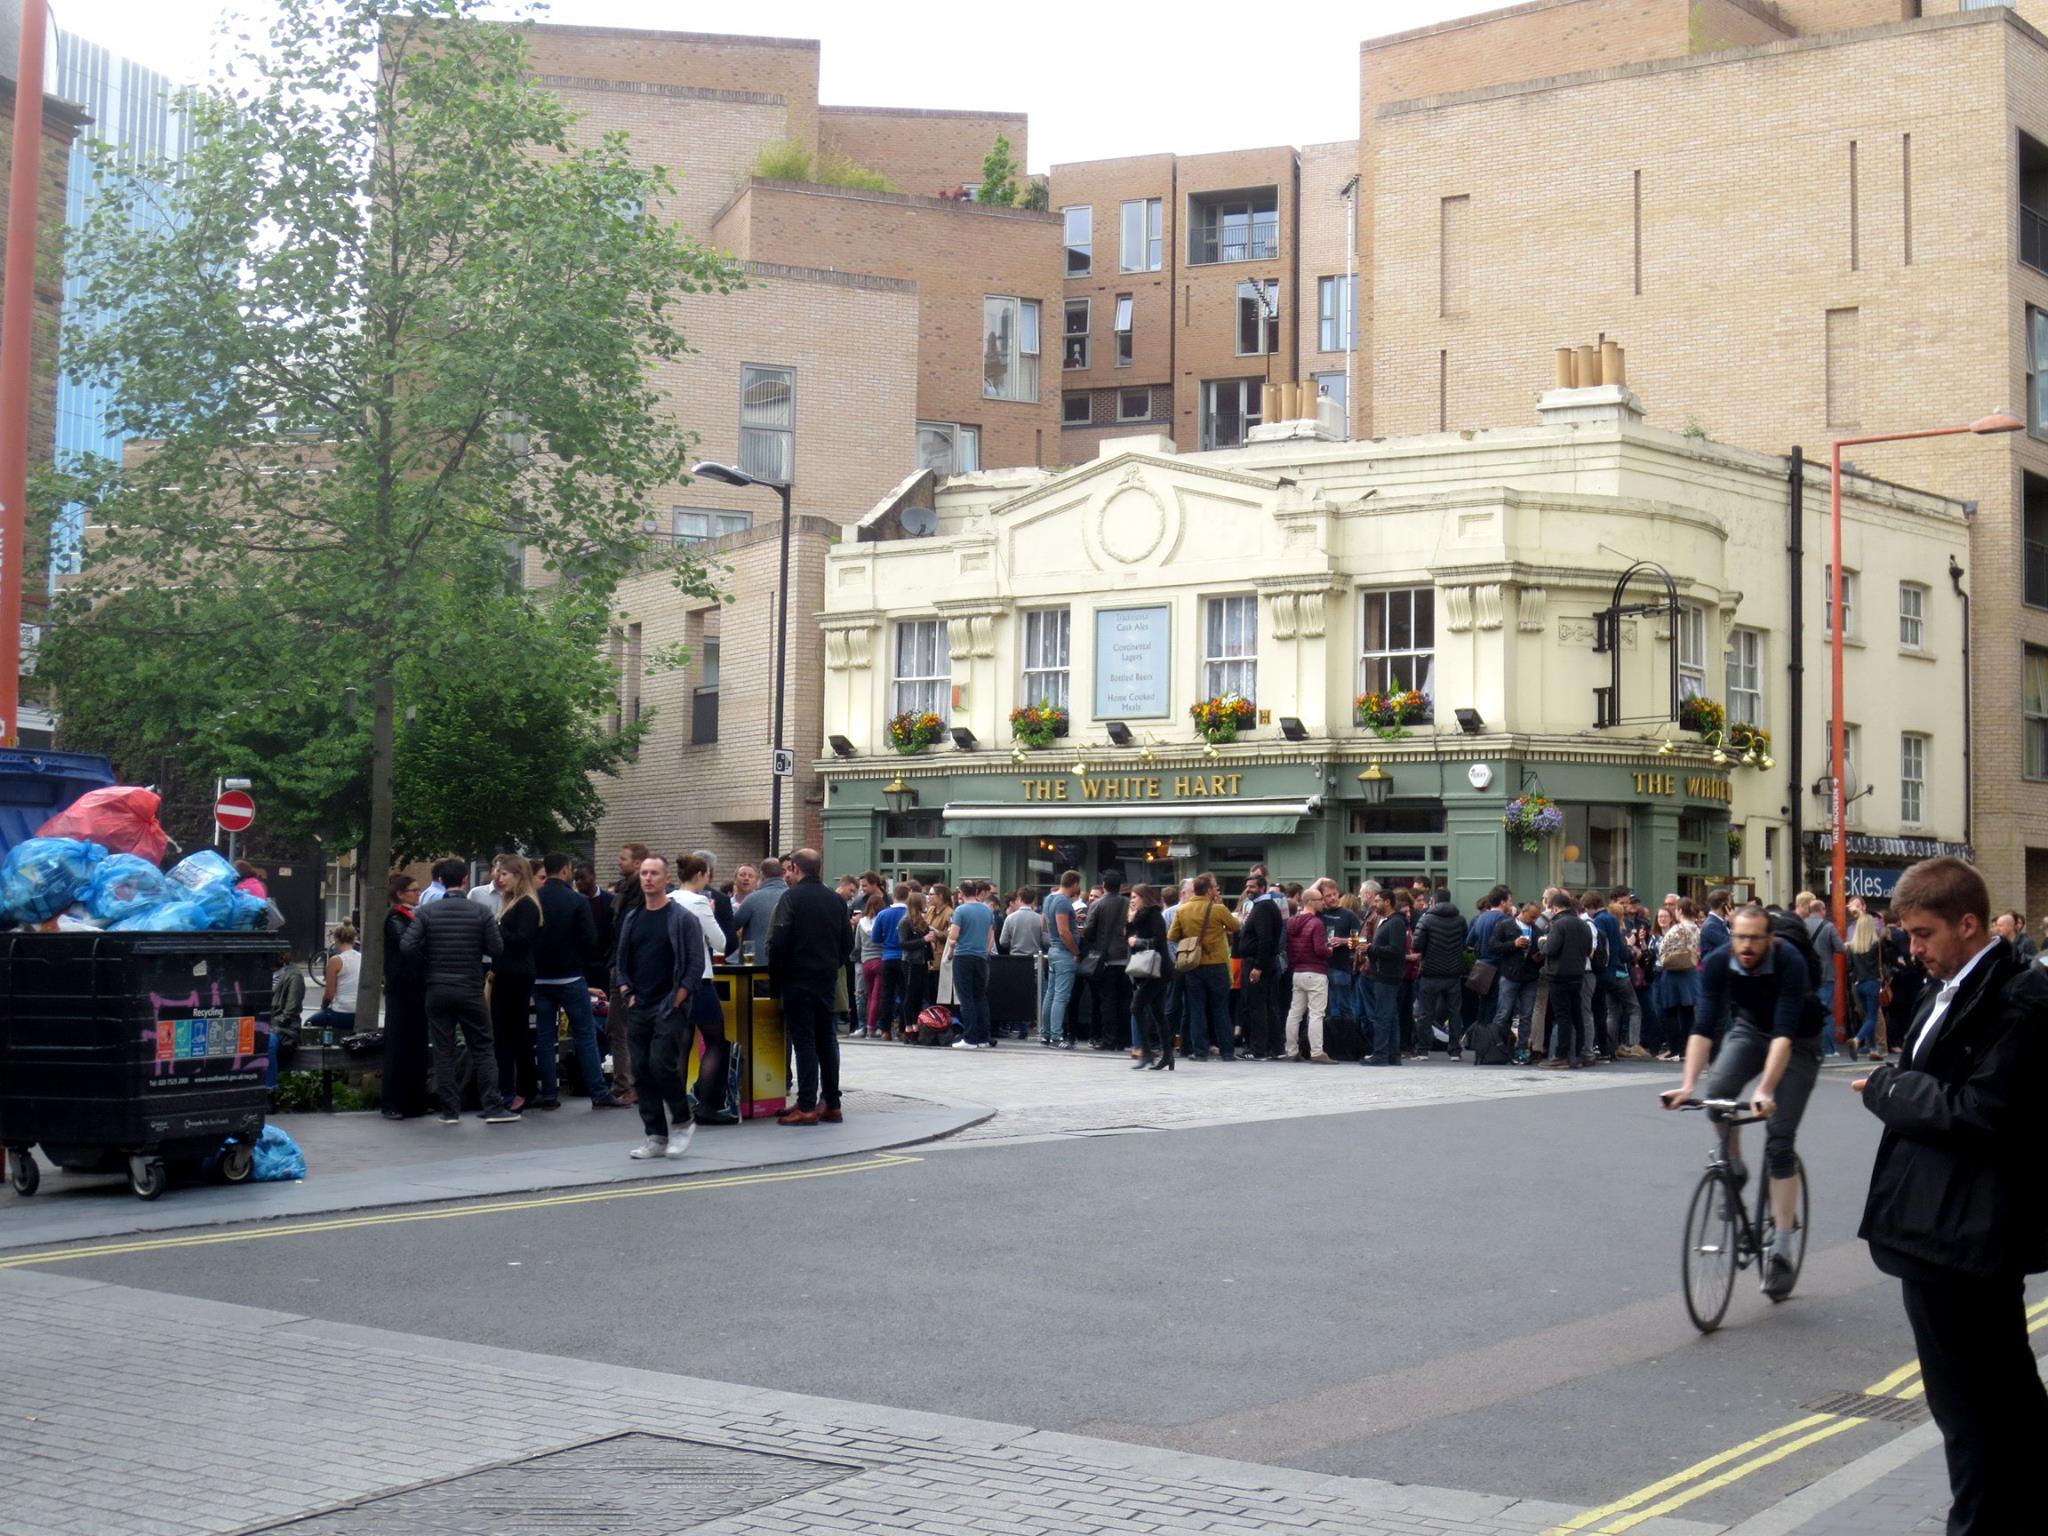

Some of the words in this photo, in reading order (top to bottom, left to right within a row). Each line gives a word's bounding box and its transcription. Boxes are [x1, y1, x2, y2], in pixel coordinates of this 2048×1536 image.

[1116, 623, 1132, 632] Cask
[1134, 623, 1149, 631] Ales
[1113, 642, 1152, 652] Continental
[1121, 653, 1143, 663] Lagers
[1135, 672, 1153, 681] Beers
[1107, 693, 1127, 702] Home
[1128, 693, 1155, 702] Cooked
[1121, 703, 1142, 712] Meals
[1021, 779, 1067, 800] THE
[1080, 777, 1162, 799] WHITE
[1174, 774, 1243, 797] HART
[1632, 771, 1676, 795] THE
[1832, 787, 1841, 825] MODERN
[1832, 826, 1841, 844] TATE
[1825, 865, 1883, 898] Pckles
[192, 1007, 224, 1018] Recycling
